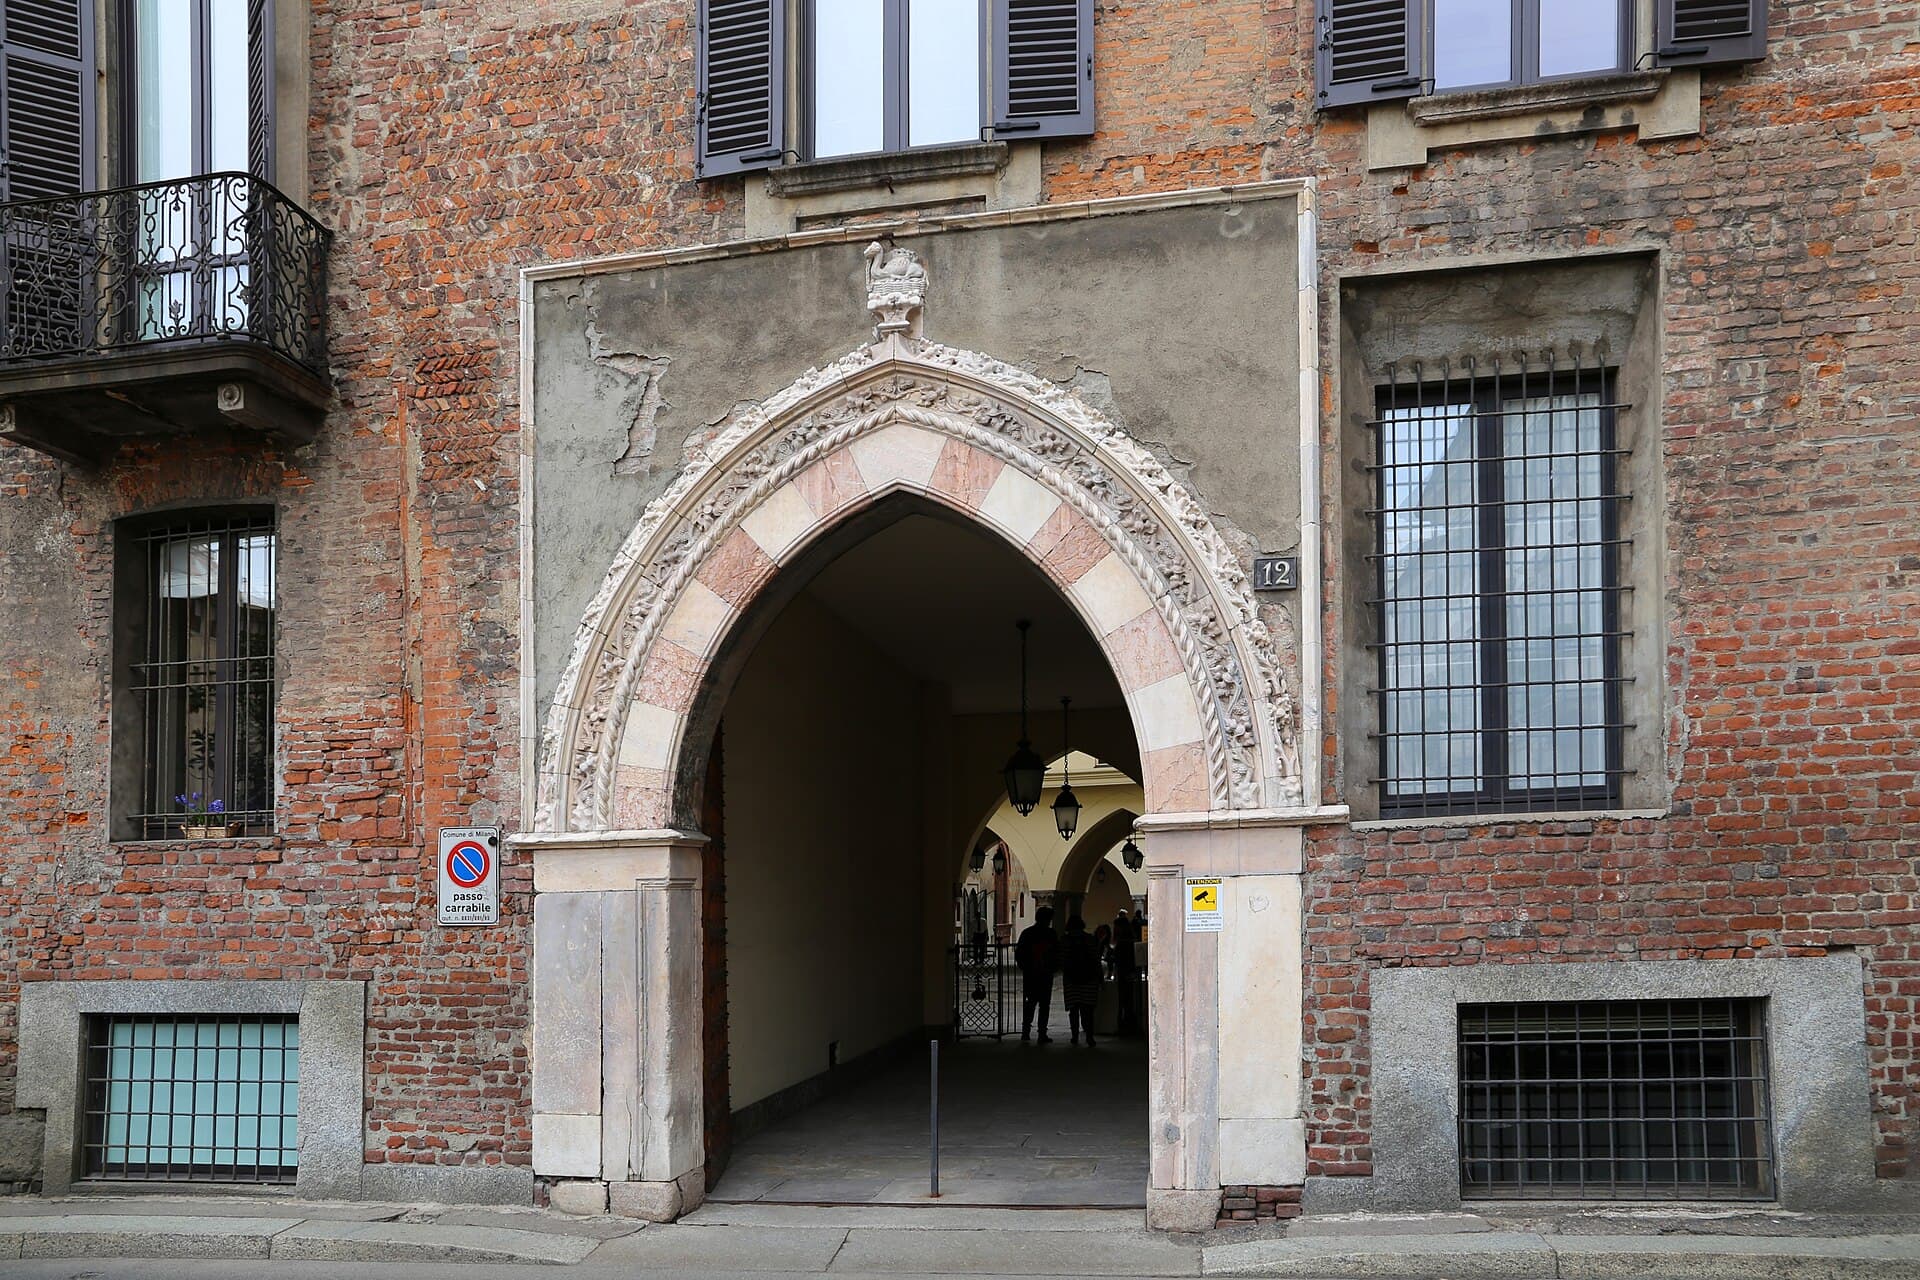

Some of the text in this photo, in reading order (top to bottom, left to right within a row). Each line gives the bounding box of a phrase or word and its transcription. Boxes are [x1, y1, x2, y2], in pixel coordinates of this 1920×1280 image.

[1262, 561, 1290, 585] 12
[453, 893, 483, 902] passo
[445, 903, 491, 912] carrabile
